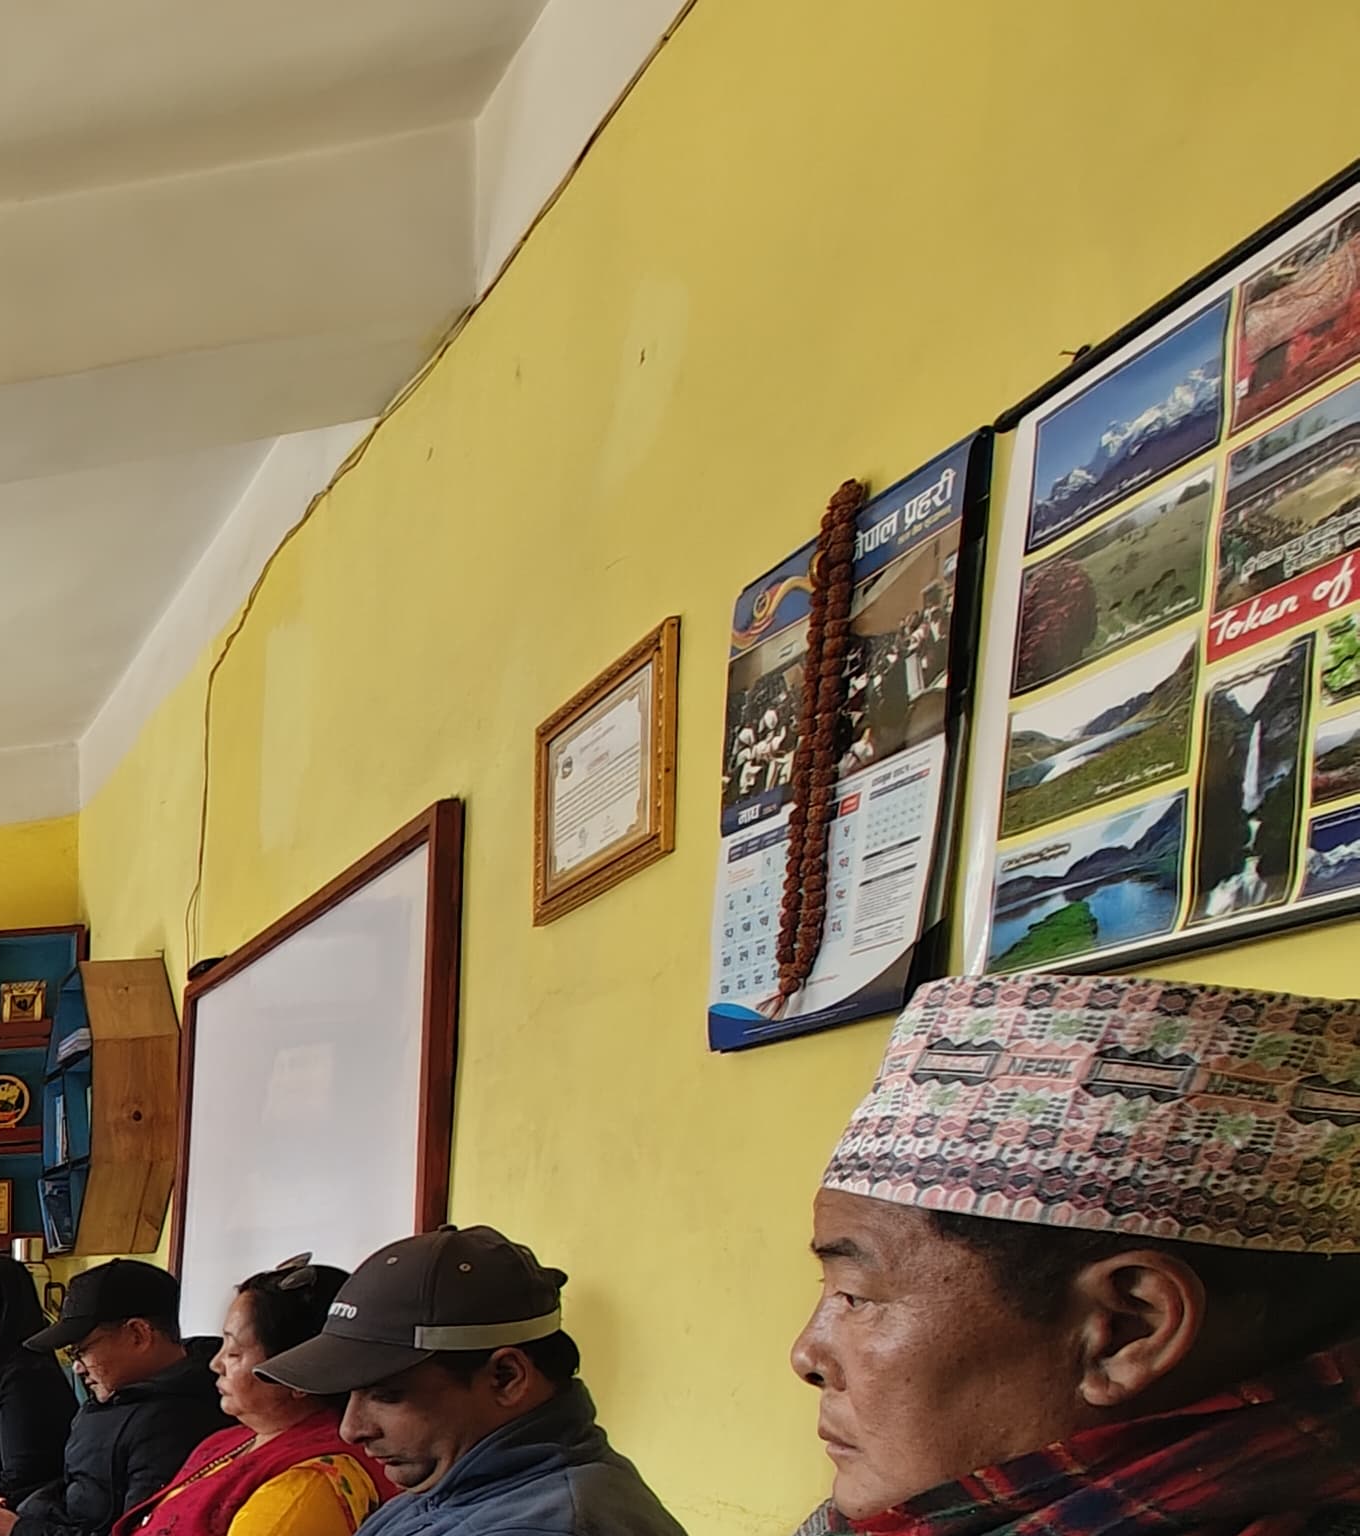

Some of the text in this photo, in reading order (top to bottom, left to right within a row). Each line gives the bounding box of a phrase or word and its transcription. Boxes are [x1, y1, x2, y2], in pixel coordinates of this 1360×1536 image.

[904, 468, 958, 531] प्रहरी
[1210, 594, 1300, 646] Token
[1312, 554, 1356, 608] of
